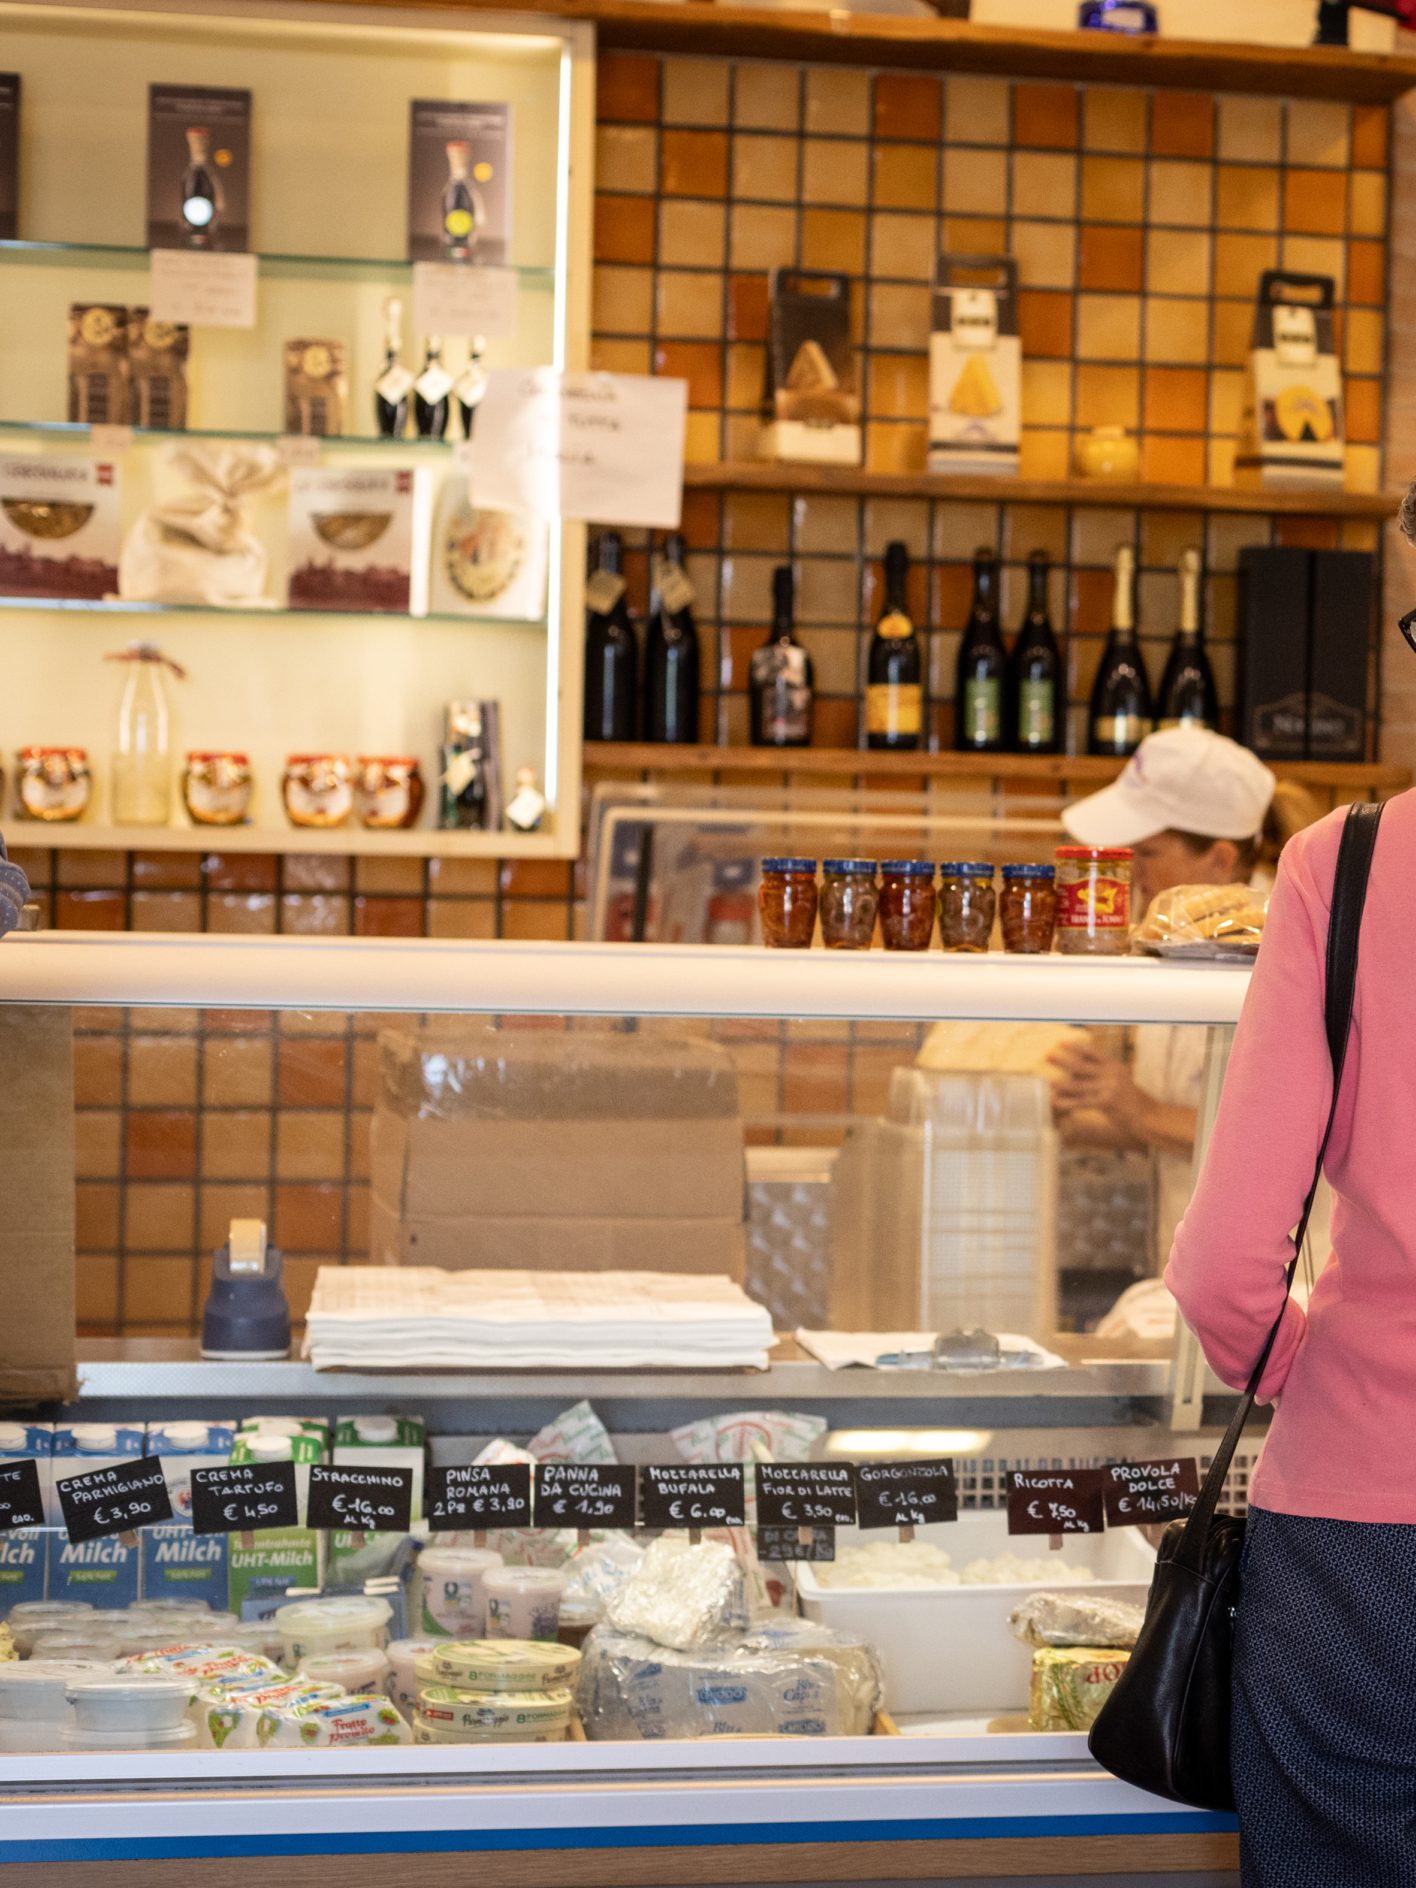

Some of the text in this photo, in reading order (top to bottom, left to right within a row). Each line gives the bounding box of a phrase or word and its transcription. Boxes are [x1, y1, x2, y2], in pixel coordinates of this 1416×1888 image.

[195, 1468, 253, 1483] CREMA
[311, 1467, 404, 1487] STRACCHINO
[446, 1467, 491, 1483] PINSA
[544, 1466, 599, 1481] PANNA
[650, 1467, 741, 1481] MOZZARELLA
[762, 1466, 849, 1481] MOZZARELLA
[860, 1466, 949, 1482] GORGONZOLA
[1111, 1462, 1180, 1482] PROVOLA
[60, 1472, 117, 1492] CREMA
[72, 1474, 164, 1504] PARMIGIANO
[658, 1482, 715, 1494] BUFALA
[1014, 1473, 1073, 1489] RICOTTA
[1129, 1478, 1175, 1493] DOLCE
[208, 1482, 284, 1497] TARTUFO
[446, 1484, 511, 1498] ROMANA
[541, 1484, 622, 1497] DA CUCINA
[762, 1483, 852, 1497] FIOR DI LATTE
[332, 1494, 347, 1513] €
[473, 1498, 484, 1512] €
[553, 1499, 567, 1514] €
[879, 1491, 892, 1506] €
[1118, 1497, 1132, 1512] €
[93, 1502, 151, 1524] € 3,90
[223, 1504, 238, 1520] €
[669, 1501, 684, 1519] €
[782, 1502, 797, 1519] €
[1027, 1501, 1043, 1519] €
[60, 1542, 128, 1564] Milch
[155, 1540, 222, 1563] Milch
[231, 1550, 313, 1568] UHT-Milch
